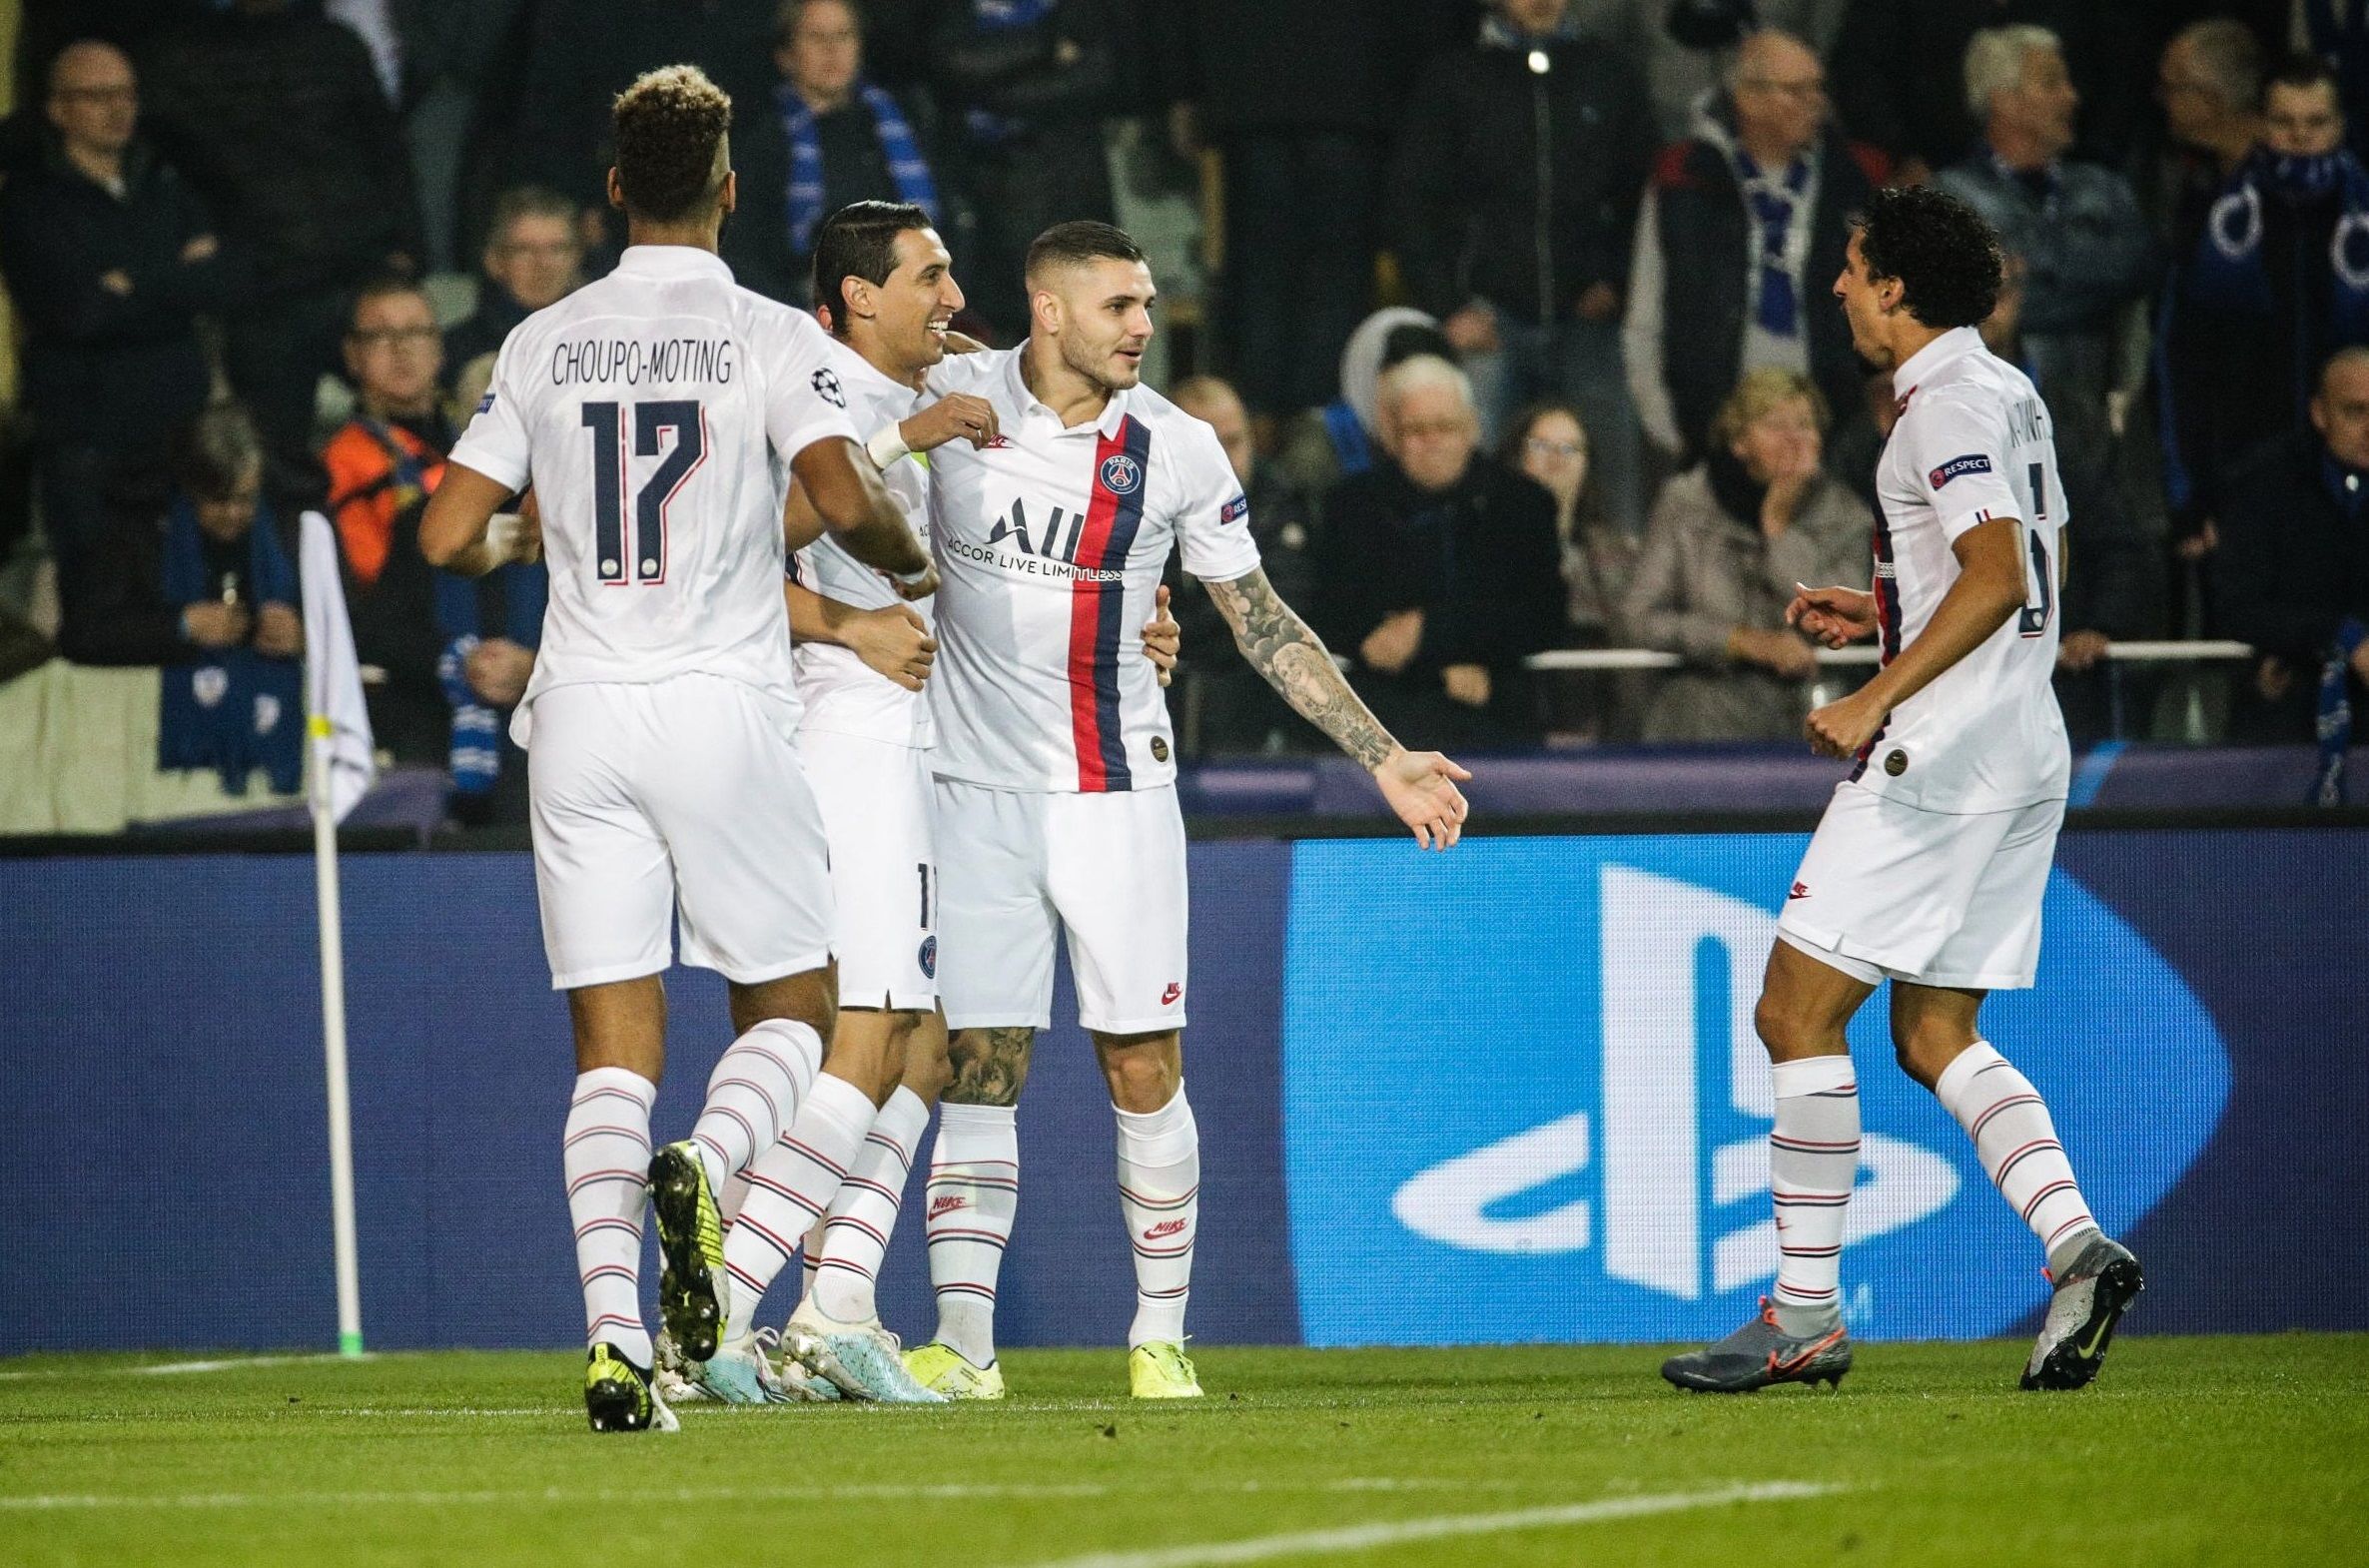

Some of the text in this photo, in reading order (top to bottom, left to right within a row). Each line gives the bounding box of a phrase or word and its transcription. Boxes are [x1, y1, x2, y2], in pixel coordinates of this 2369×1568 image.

[552, 339, 731, 386] CHOUPO-MOTING
[1944, 458, 1990, 476] RESPECT
[581, 399, 707, 585] 17
[948, 535, 1123, 580] ACCOR LIVE LIMITLESS
[933, 1196, 966, 1209] NIKE
[1154, 1217, 1186, 1231] NIKE
